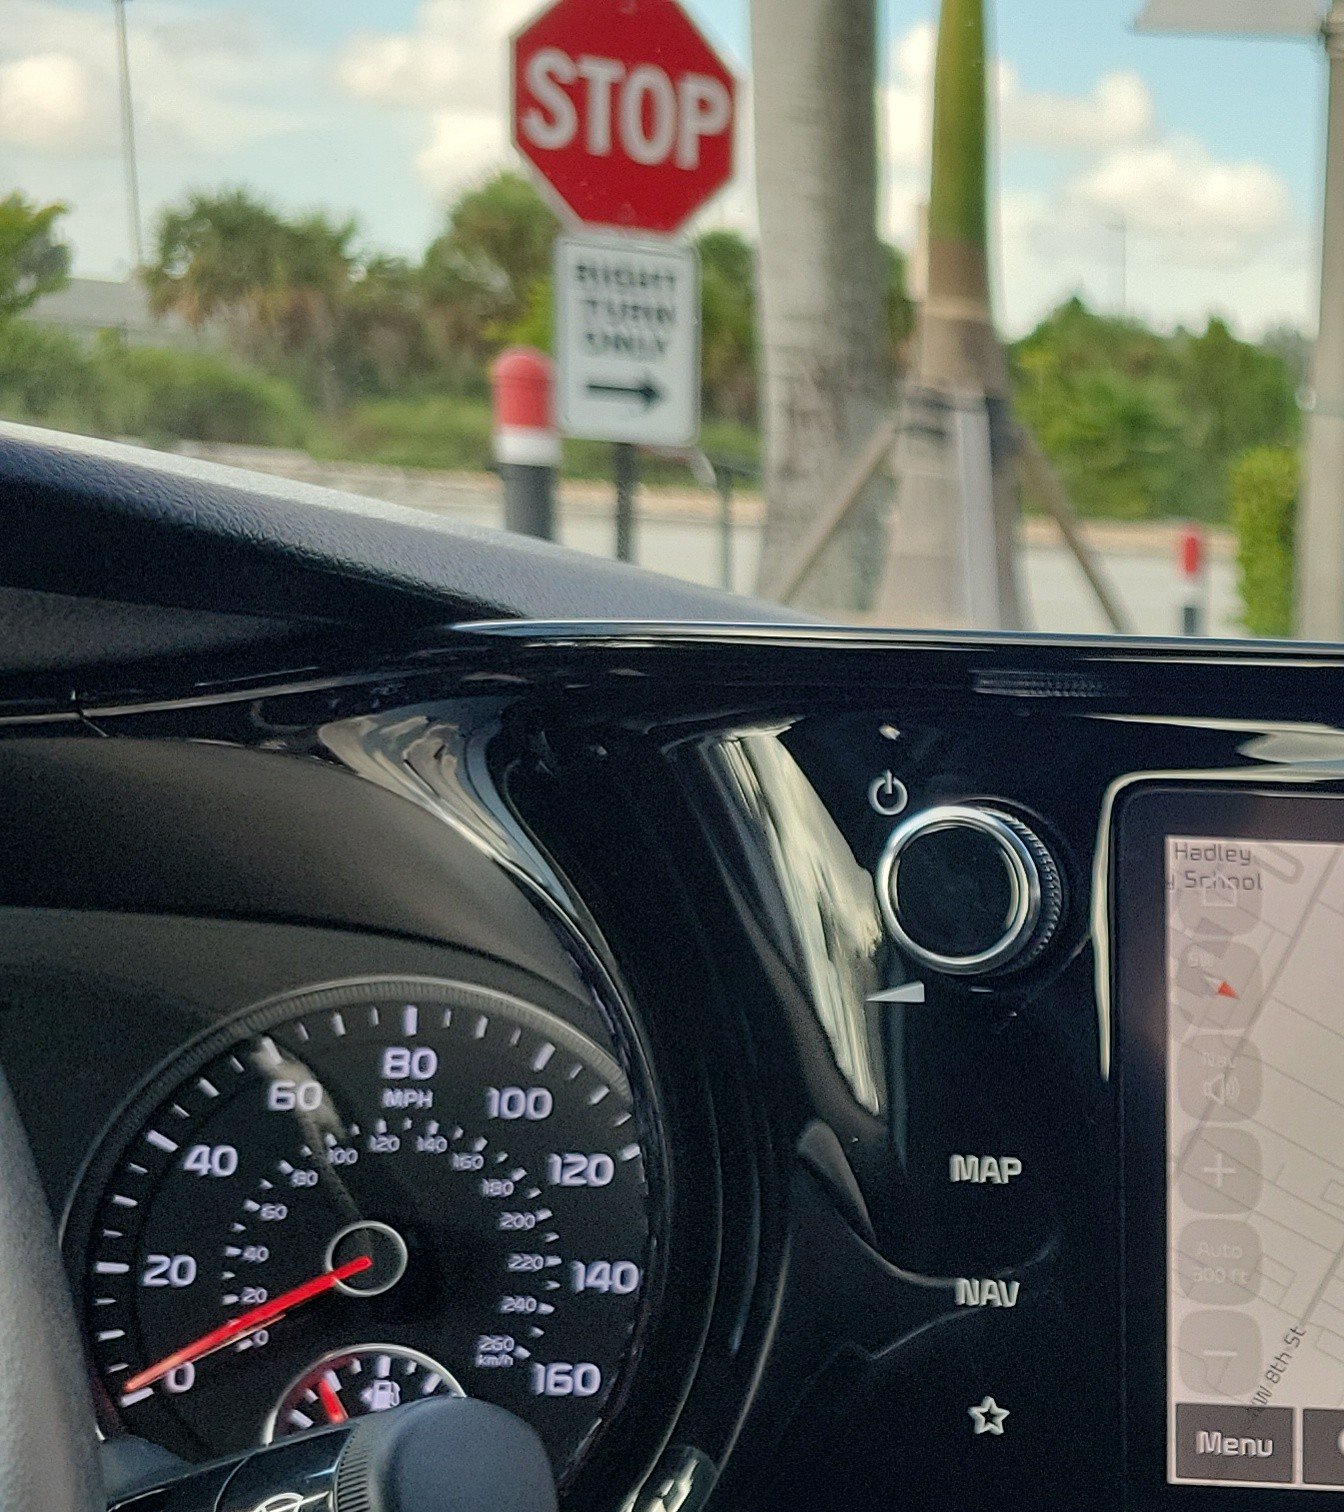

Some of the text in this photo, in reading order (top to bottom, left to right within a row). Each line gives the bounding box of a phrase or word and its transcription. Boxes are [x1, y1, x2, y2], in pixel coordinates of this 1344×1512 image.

[521, 46, 731, 172] STOP
[1174, 842, 1252, 867] Hadley
[1184, 870, 1263, 891] School
[381, 1046, 438, 1080] 80
[267, 1079, 323, 1111] 60
[381, 1087, 434, 1109] MPH
[486, 1086, 553, 1120] 100
[326, 1147, 359, 1165] 100
[369, 1134, 400, 1153] 120
[417, 1135, 448, 1154] 140
[182, 1143, 239, 1177] 40
[452, 1152, 485, 1171] 160
[547, 1152, 615, 1187] 120
[949, 1154, 1022, 1184] MAP
[290, 1169, 319, 1187] 80
[481, 1177, 515, 1197] 180
[260, 1203, 288, 1221] 60
[499, 1211, 536, 1231] 200
[240, 1245, 270, 1263] 40
[506, 1252, 545, 1272] 220
[141, 1253, 197, 1287] 20
[568, 1260, 640, 1295] 140
[240, 1286, 268, 1305] 20
[954, 1277, 1020, 1308] NAV
[499, 1296, 537, 1315] 240
[1264, 1352, 1293, 1384] 8th
[1283, 1325, 1307, 1348] St
[165, 1361, 196, 1393] 0
[531, 1361, 602, 1397] 160
[1195, 1430, 1275, 1458] Menu
